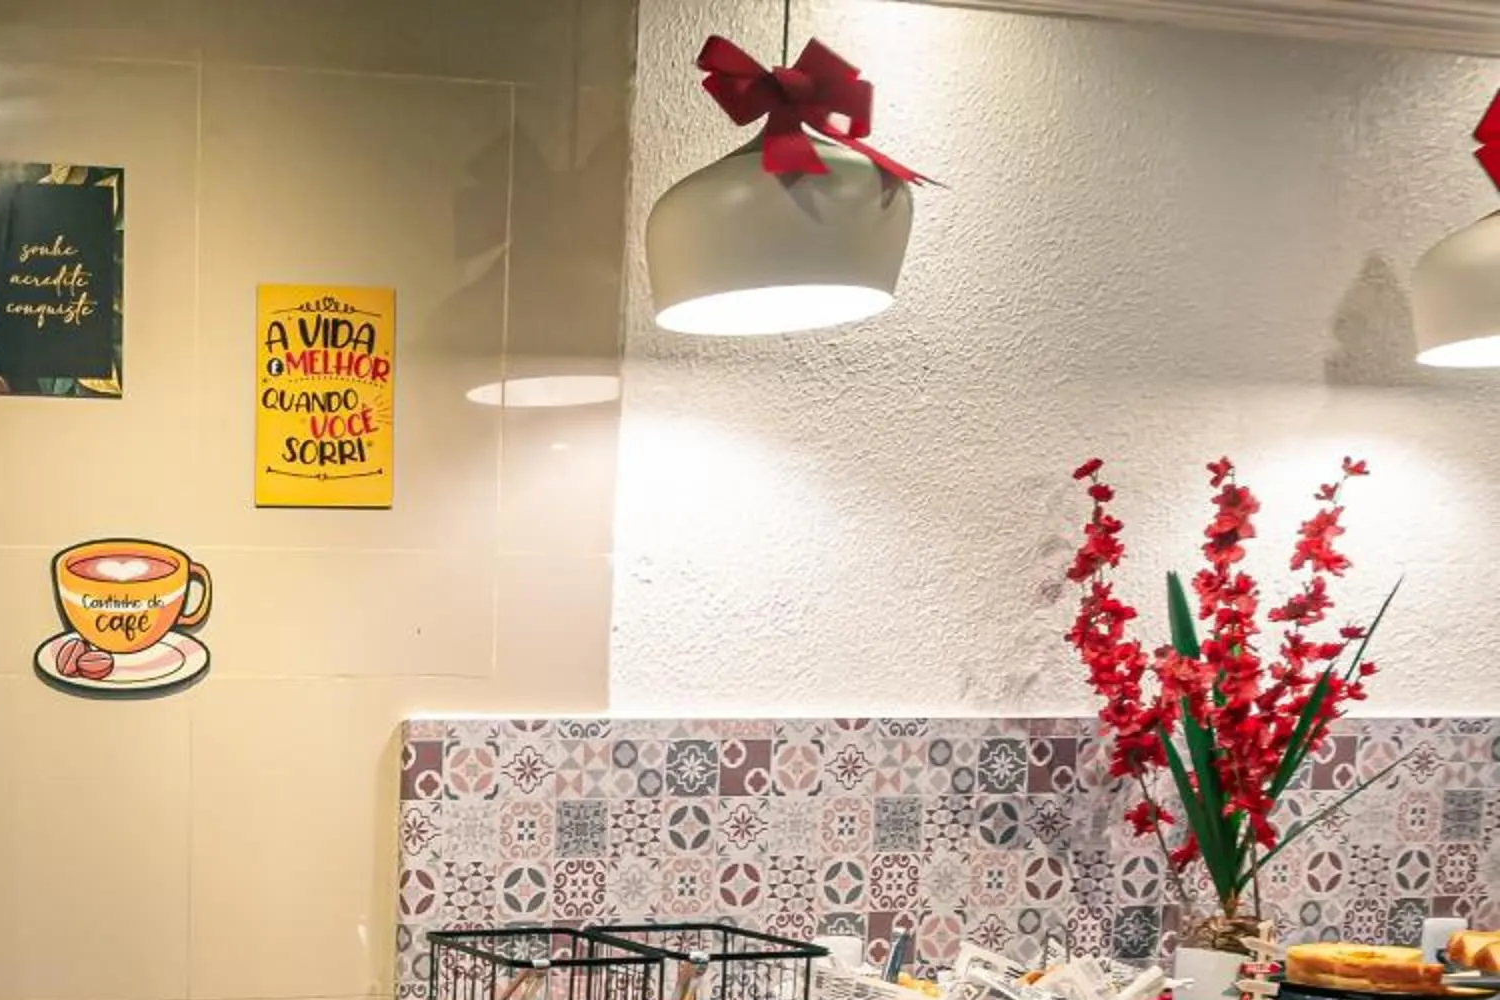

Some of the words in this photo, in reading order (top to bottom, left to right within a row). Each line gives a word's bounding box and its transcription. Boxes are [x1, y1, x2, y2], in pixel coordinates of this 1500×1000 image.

[9, 264, 92, 297] acredite
[5, 292, 98, 328] conquiste
[265, 320, 289, 352] A
[298, 314, 377, 355] VIDA
[285, 349, 390, 382] MELHOR
[262, 387, 359, 413] QUANDO
[310, 402, 380, 440] VOCÊ
[282, 437, 367, 466] SORRI
[95, 610, 152, 642] café
